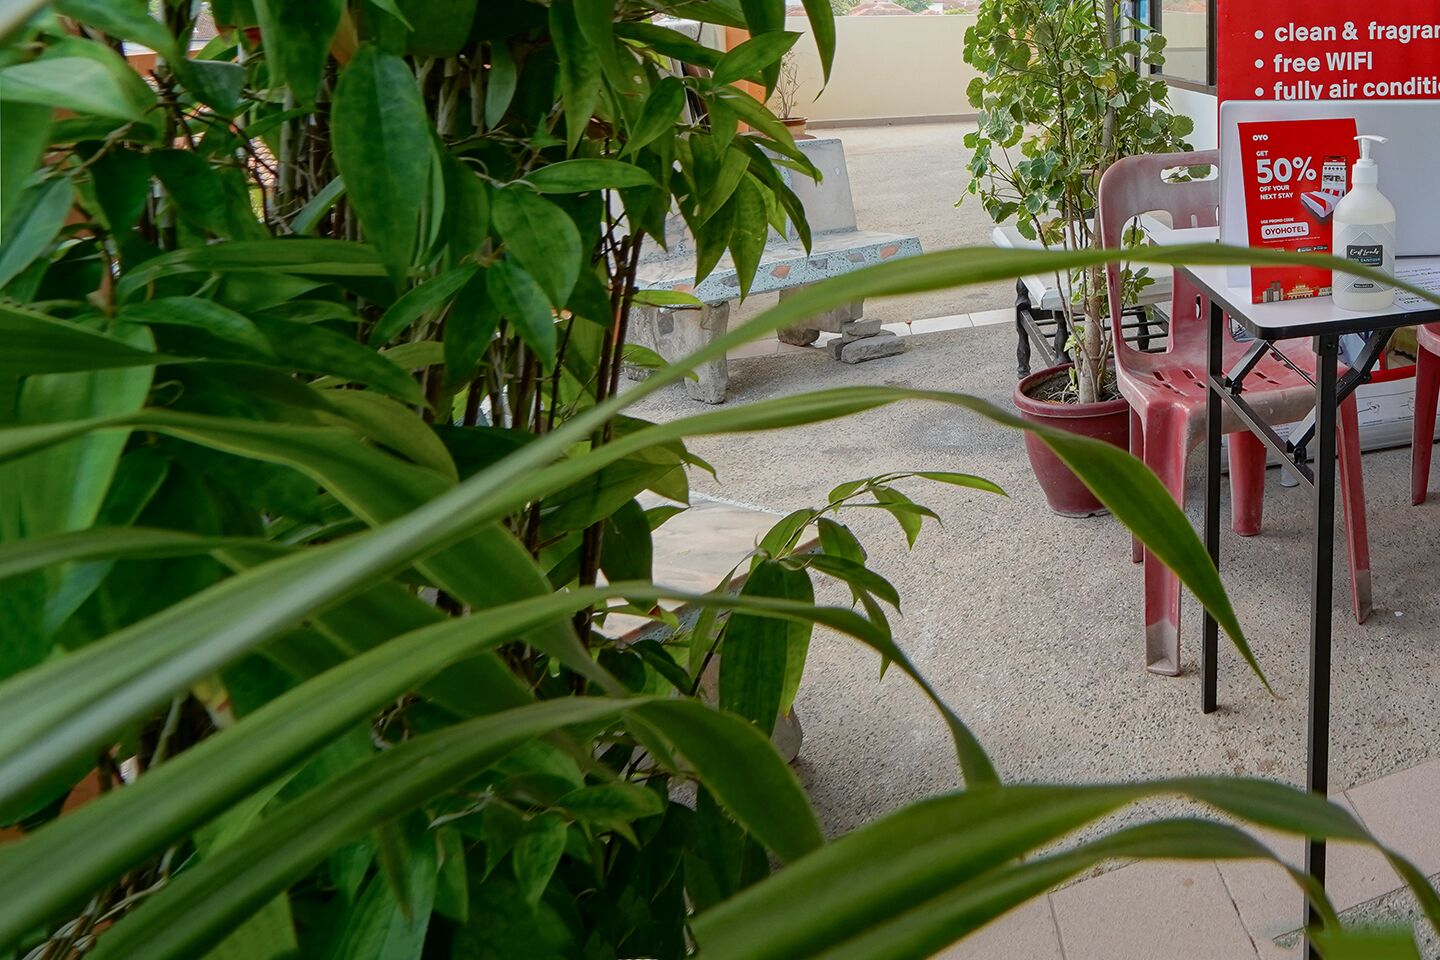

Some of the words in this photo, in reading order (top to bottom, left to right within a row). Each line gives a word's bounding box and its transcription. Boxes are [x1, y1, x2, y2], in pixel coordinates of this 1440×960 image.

[1275, 22, 1337, 41] clean
[1342, 22, 1358, 40] &
[1273, 54, 1320, 72] free
[1326, 51, 1373, 70] WIFI
[1273, 81, 1323, 100] fully
[1329, 80, 1357, 98] air
[1256, 156, 1317, 184] 50%
[1265, 226, 1306, 235] OYOHOTEL
